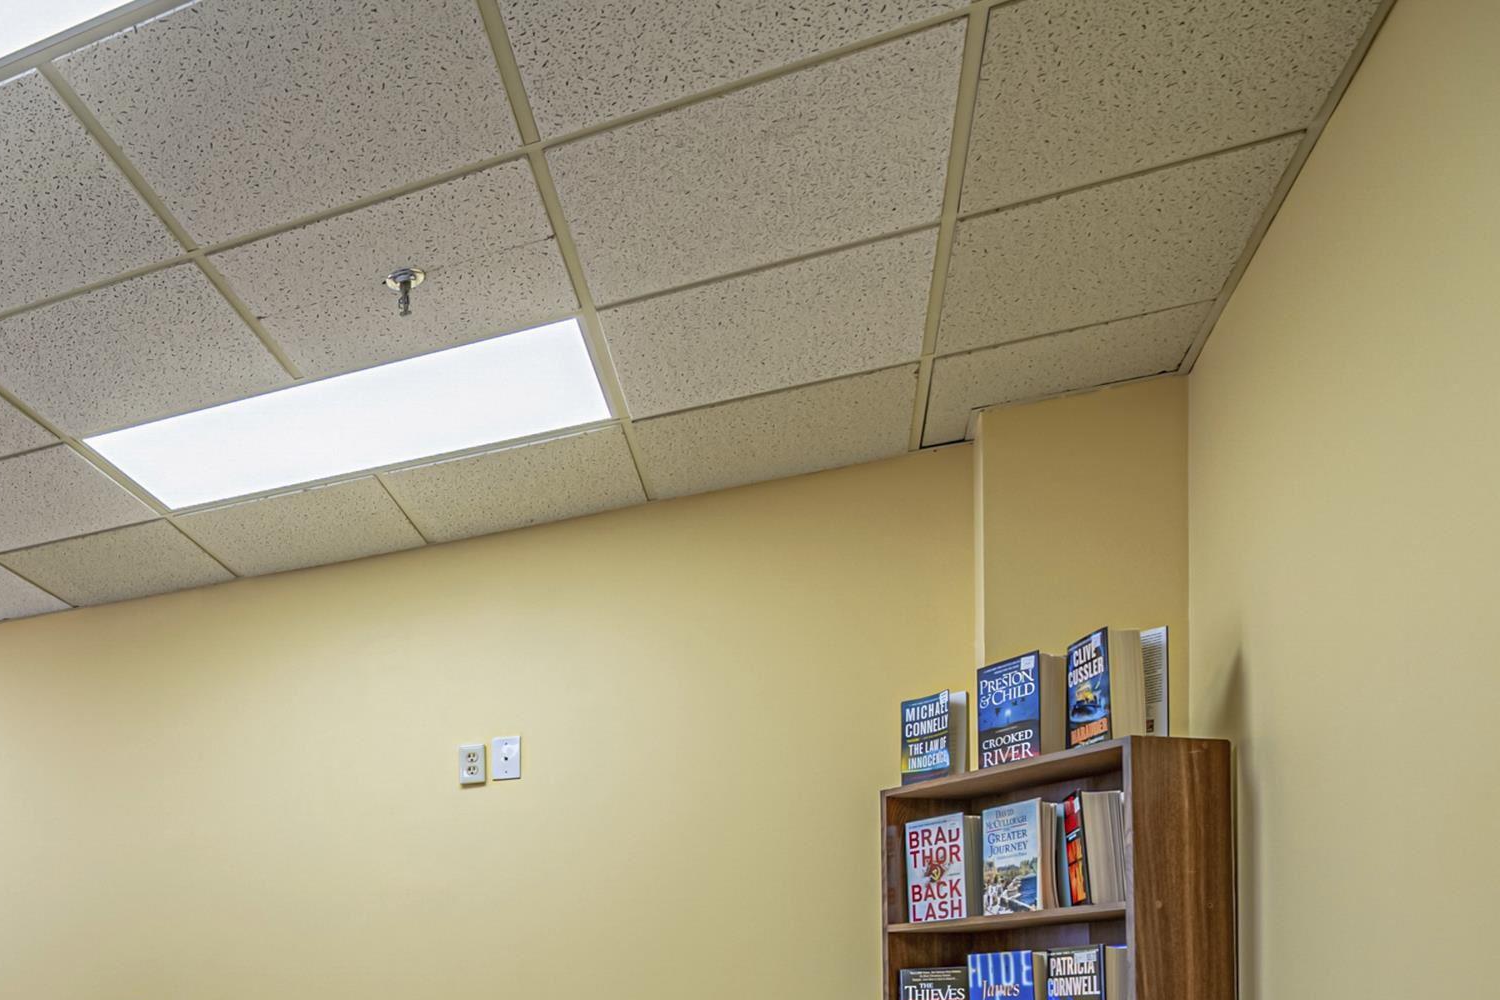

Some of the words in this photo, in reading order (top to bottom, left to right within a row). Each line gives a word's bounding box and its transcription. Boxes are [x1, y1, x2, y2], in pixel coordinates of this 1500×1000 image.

[1072, 643, 1097, 667] CLIVE
[979, 668, 1035, 695] PRESTON
[1068, 655, 1105, 688] CUSSLER
[905, 701, 949, 722] MICHAEL
[905, 714, 949, 738] CONNELLY
[908, 742, 924, 756] THE
[925, 739, 941, 755] LAW
[938, 736, 948, 750] OF
[982, 729, 1033, 751] CROOKED
[908, 751, 949, 770] INNOCENCE
[983, 741, 1035, 769] RIVER
[909, 825, 960, 850] BRAD
[988, 829, 1028, 845] GREATER
[910, 844, 961, 869] THOR
[988, 840, 1029, 858] JOURNEY
[911, 878, 962, 903] BACK
[912, 900, 962, 922] LASH
[969, 951, 1034, 988] HIDE
[1049, 957, 1096, 977] PATRICIA
[918, 982, 934, 990] THE
[982, 981, 1021, 1000] James
[1048, 975, 1101, 997] CORNWELL
